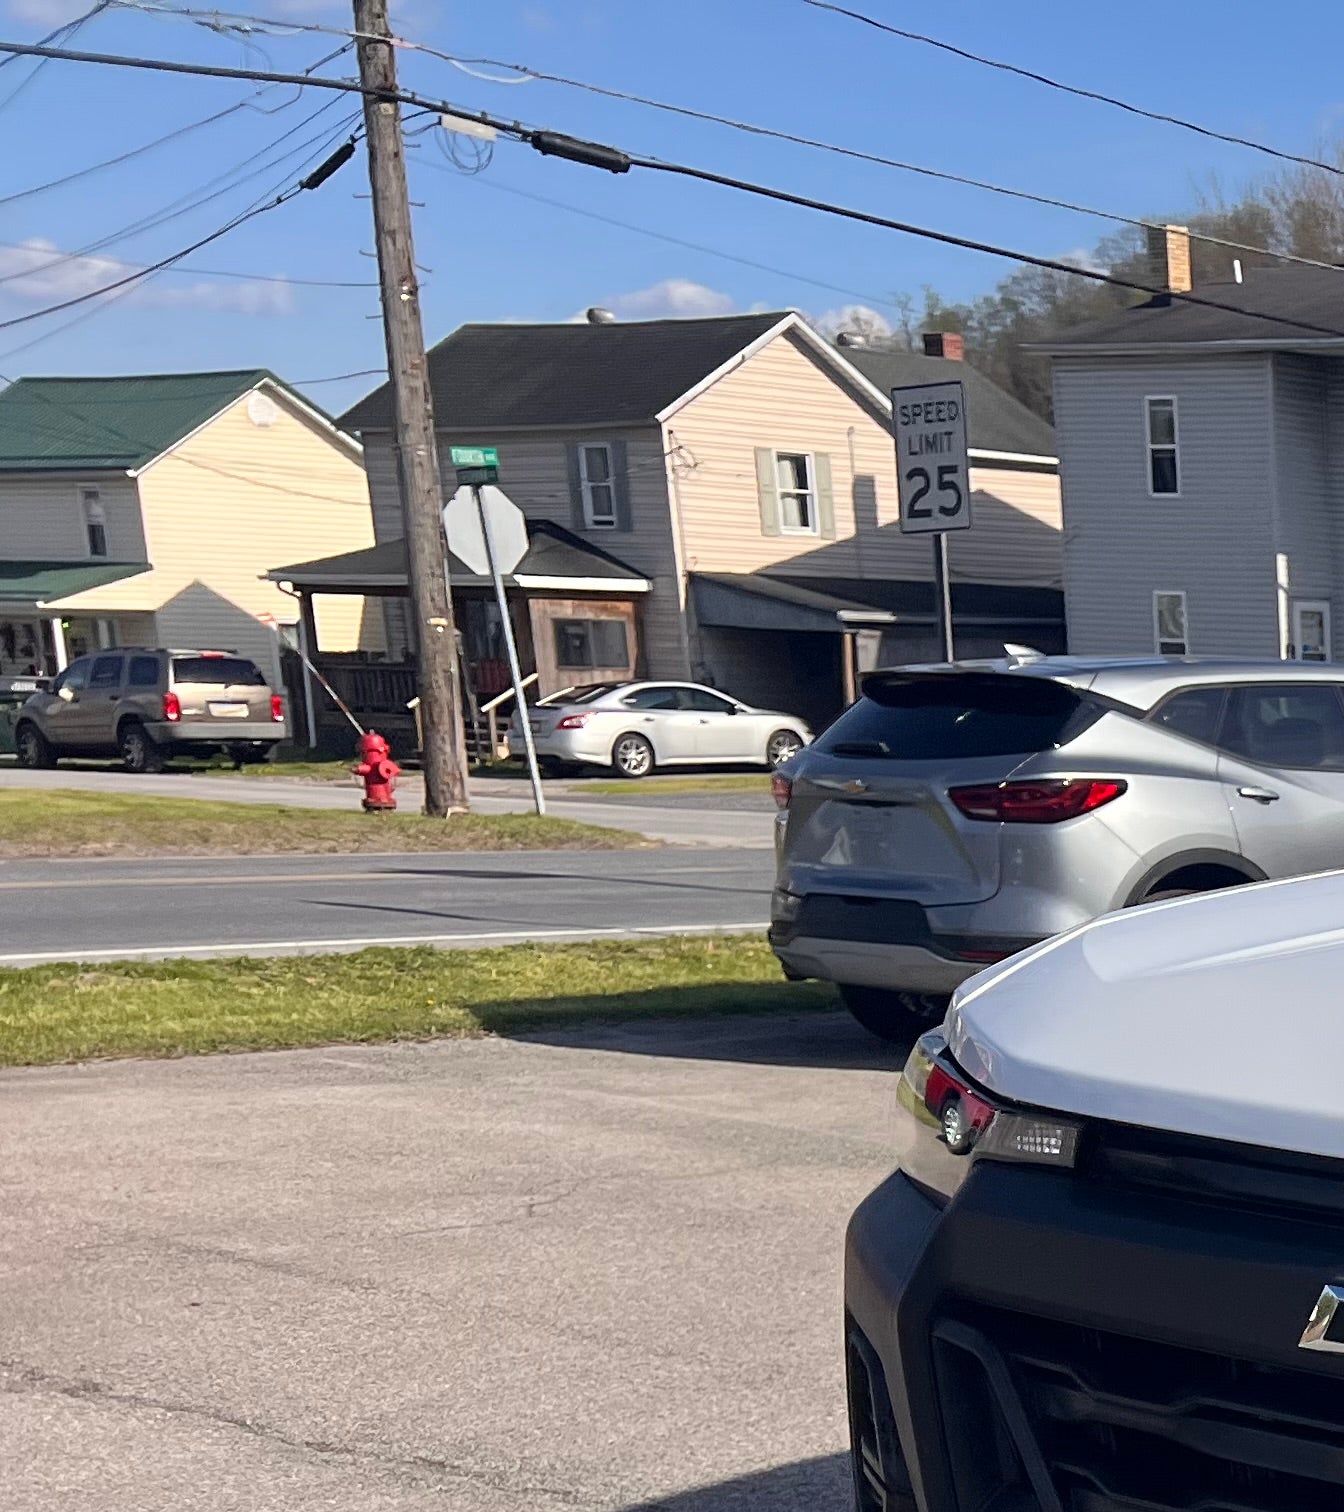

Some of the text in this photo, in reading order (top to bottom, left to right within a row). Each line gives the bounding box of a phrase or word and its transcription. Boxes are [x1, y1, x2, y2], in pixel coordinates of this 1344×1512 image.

[900, 400, 960, 426] SPEED
[908, 431, 953, 455] LIMIT
[906, 465, 962, 519] 25
